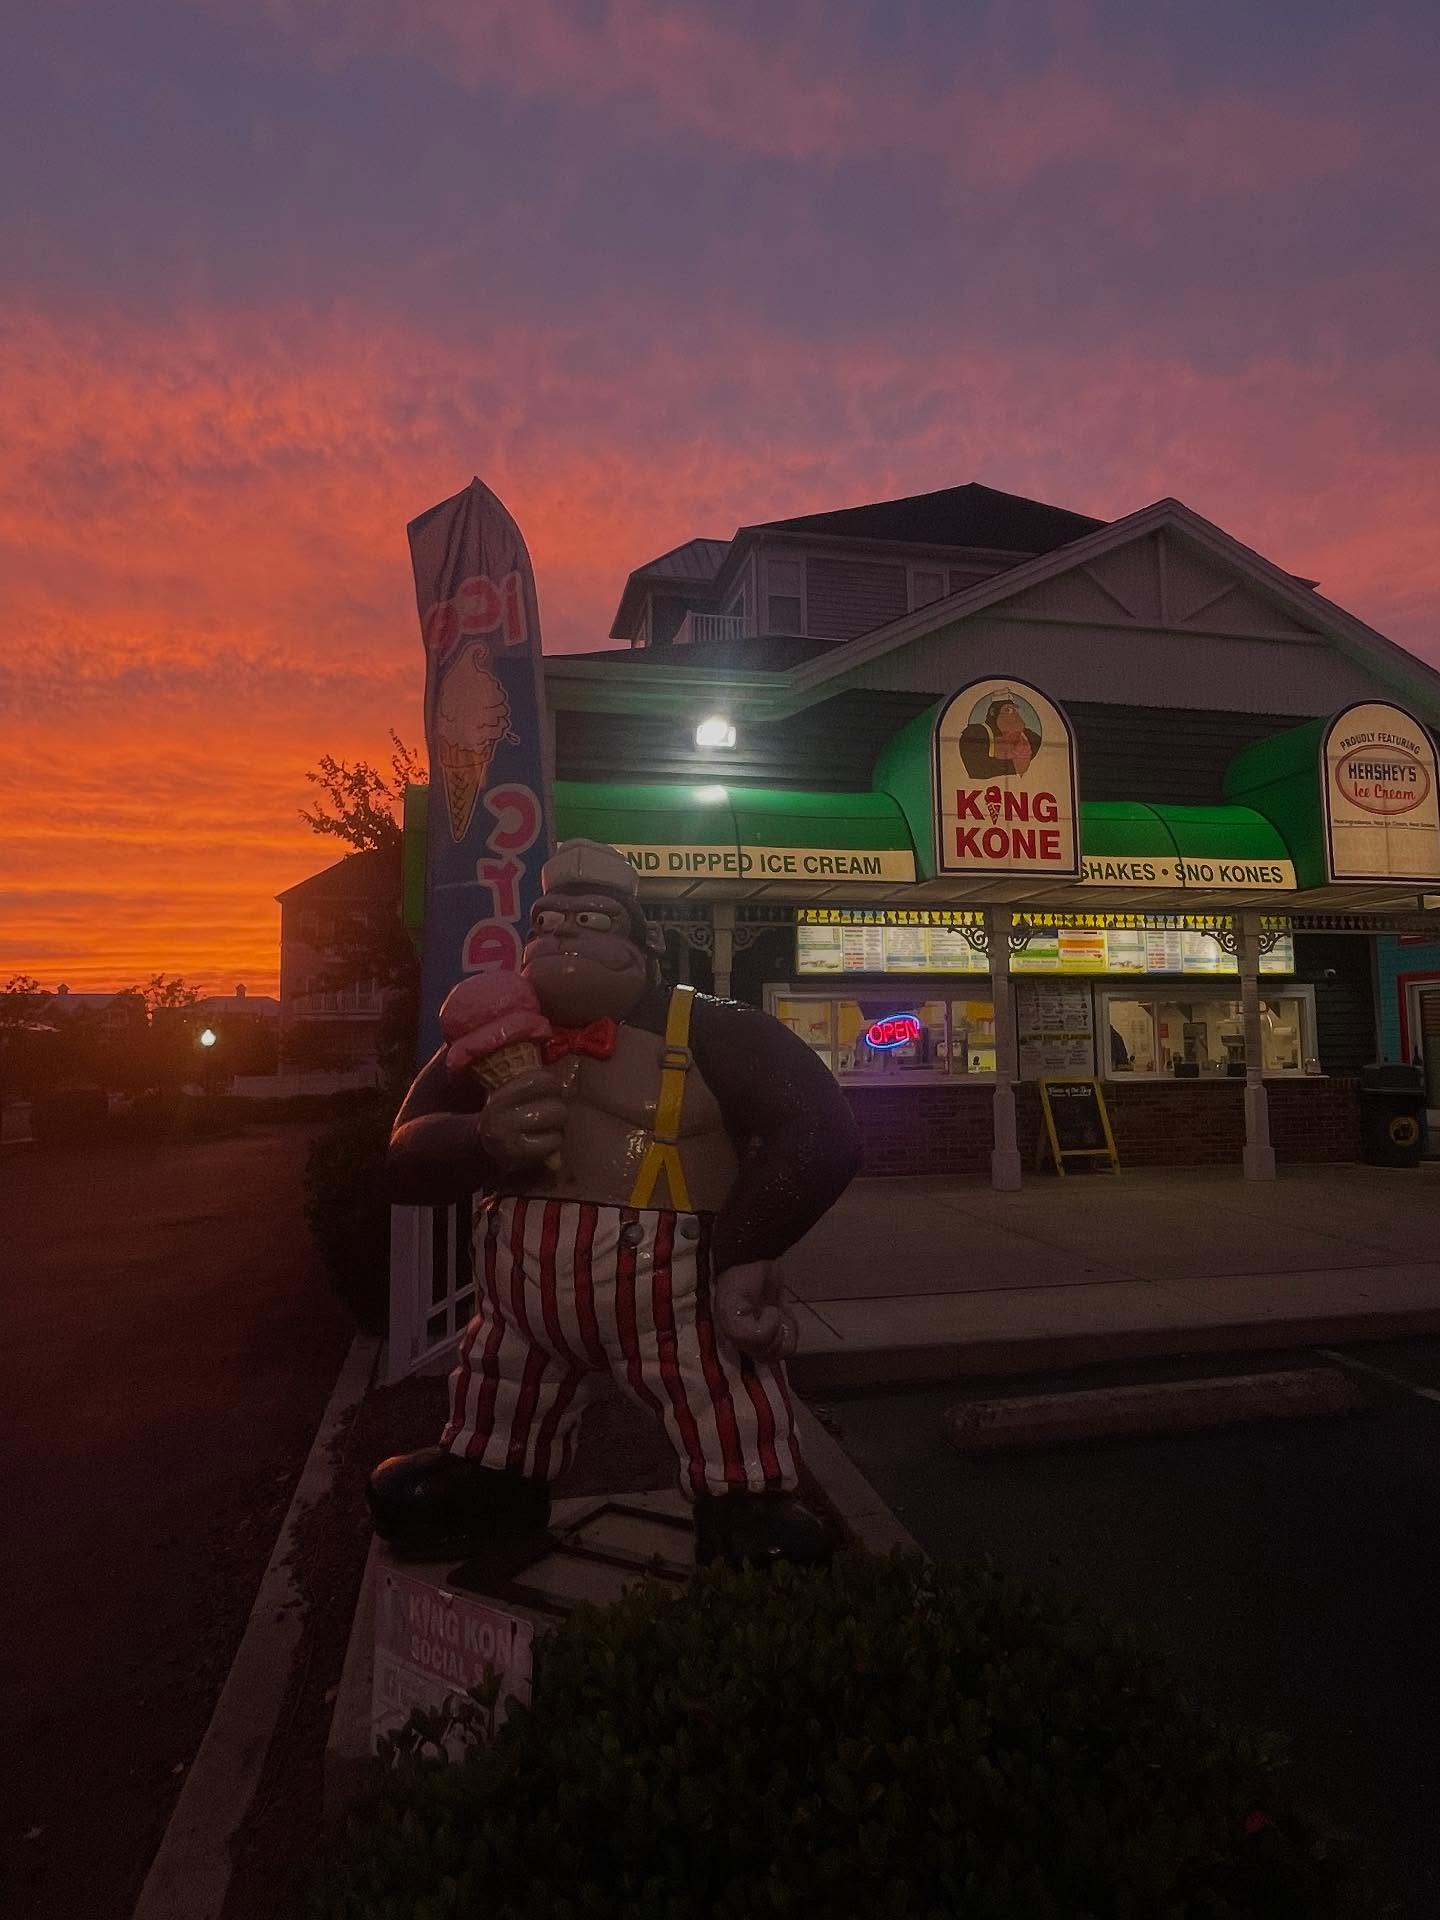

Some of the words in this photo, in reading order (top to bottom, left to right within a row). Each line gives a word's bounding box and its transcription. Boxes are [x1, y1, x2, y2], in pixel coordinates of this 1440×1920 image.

[1340, 732, 1375, 751] PROUDLY
[1377, 732, 1421, 755] FEATURING
[1348, 763, 1417, 782] HERSHEY'S
[1353, 781, 1370, 798] Ice
[1374, 783, 1417, 801] Cream
[955, 827, 1062, 860] KONE
[668, 852, 753, 872] DIPPED
[760, 854, 798, 873] ICE
[803, 855, 882, 875] CREAM
[1081, 862, 1156, 881] SHAKES
[1174, 863, 1214, 882] SNO
[1218, 865, 1284, 884] KONES
[868, 1020, 919, 1044] OPEN
